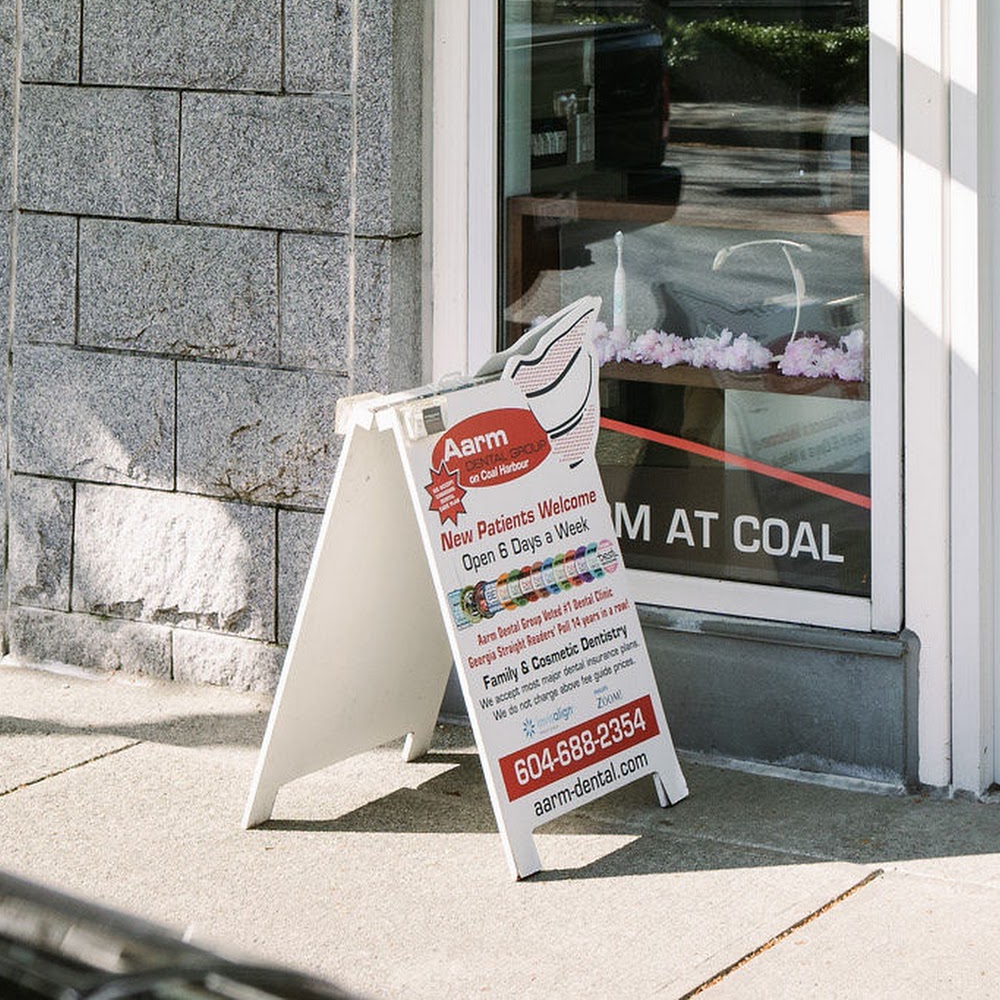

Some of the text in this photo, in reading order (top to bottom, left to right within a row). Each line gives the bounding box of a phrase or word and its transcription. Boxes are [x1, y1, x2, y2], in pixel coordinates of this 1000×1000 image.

[443, 429, 508, 462] Aarm
[464, 439, 547, 473] DENTAL GROUP
[480, 467, 498, 482] Coal
[499, 459, 530, 476] Harbour
[441, 490, 597, 551] New Patients Welcome
[462, 517, 590, 573] Open 6 Days a Week
[666, 510, 718, 547] AT
[733, 514, 845, 563] COAL
[467, 650, 497, 669] Georgia
[497, 638, 527, 658] Straight
[557, 620, 571, 635] Poll
[582, 612, 601, 628] years
[601, 607, 608, 618] in
[477, 588, 613, 646] Aarm Dental Group Voted #1 Dental Clinic
[480, 697, 494, 709] We
[495, 687, 520, 704] accept
[522, 679, 541, 693] most
[542, 671, 562, 685] major
[564, 659, 585, 676] dental
[587, 648, 619, 667] insurance
[483, 625, 628, 690] Family & Cosmetic Dentistry
[493, 708, 507, 721] We
[508, 705, 518, 715] do
[520, 699, 532, 710] not
[533, 689, 559, 705] charge
[560, 681, 580, 694] above
[581, 674, 592, 684] fee
[593, 666, 613, 682] guide
[514, 707, 646, 786] 604-688-2354
[533, 751, 649, 817] aarm-dental.com
